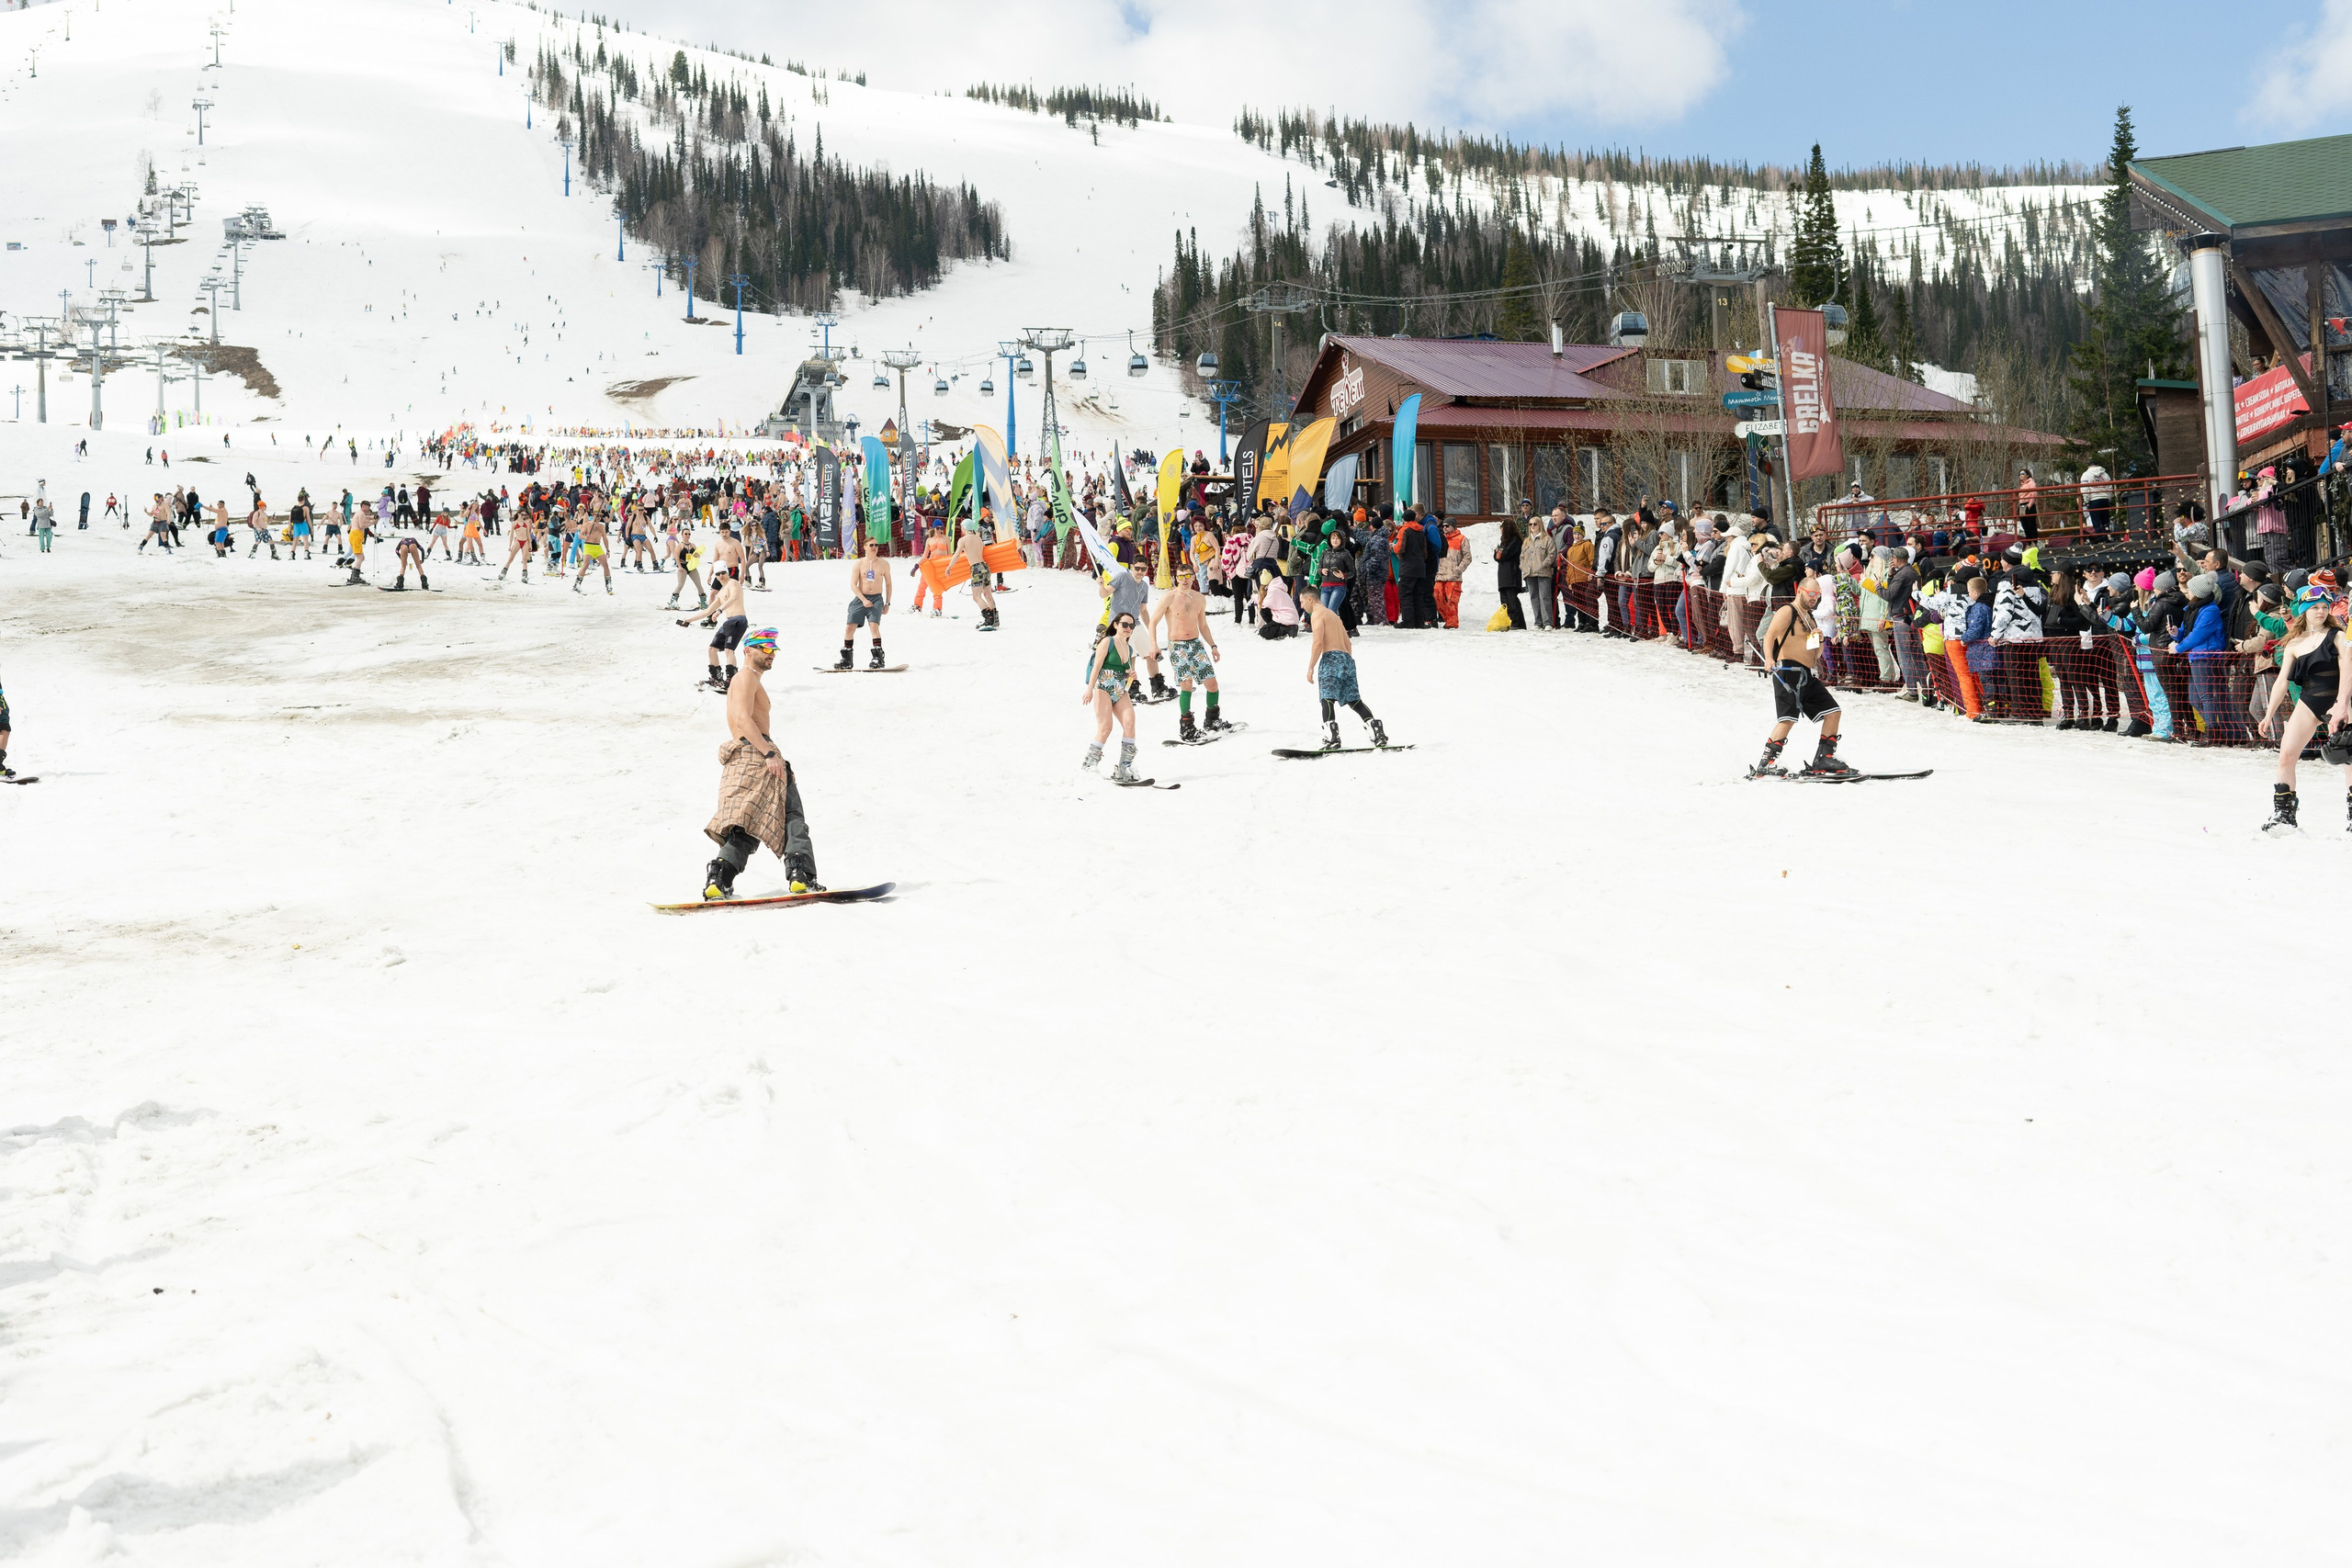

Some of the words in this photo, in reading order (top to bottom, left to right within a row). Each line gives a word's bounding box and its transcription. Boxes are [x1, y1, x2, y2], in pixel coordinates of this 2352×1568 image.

[1717, 298, 1728, 306] 13
[1791, 351, 1819, 434] GRELKA
[1727, 396, 1762, 405] Mammoth
